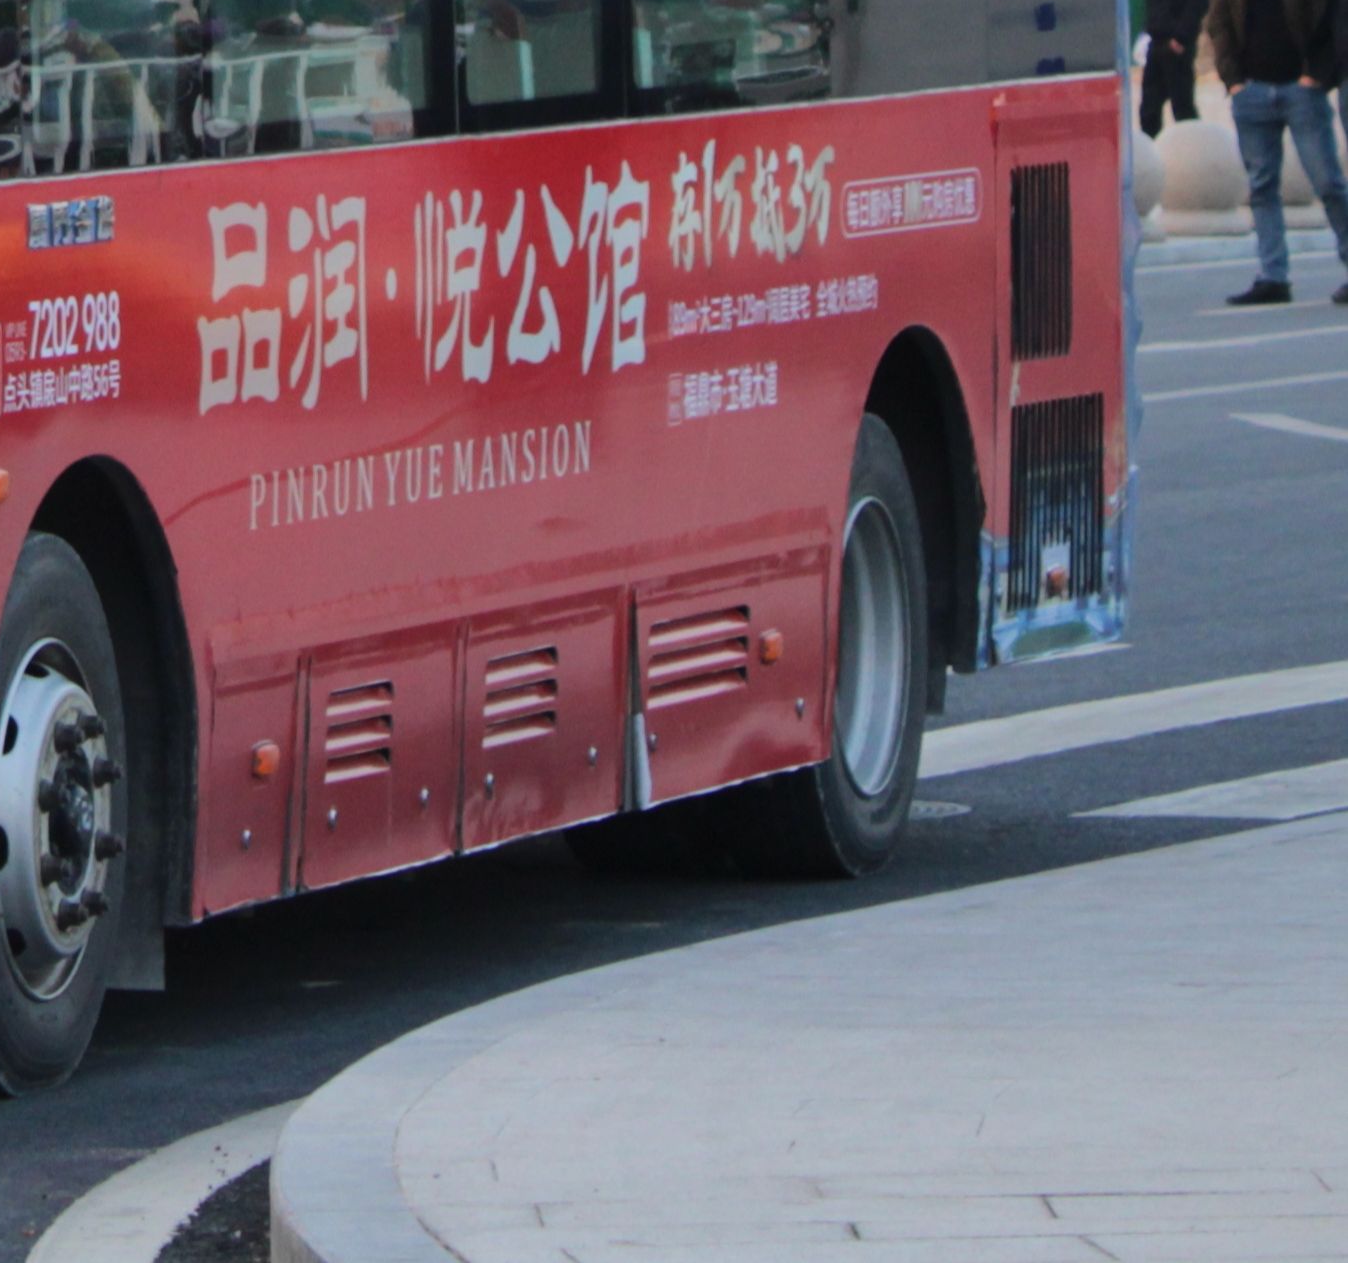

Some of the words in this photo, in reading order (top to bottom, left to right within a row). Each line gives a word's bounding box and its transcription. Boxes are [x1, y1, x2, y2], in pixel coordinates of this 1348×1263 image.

[28, 297, 79, 361] 7202
[82, 290, 121, 353] 988
[452, 420, 592, 496] MANSION
